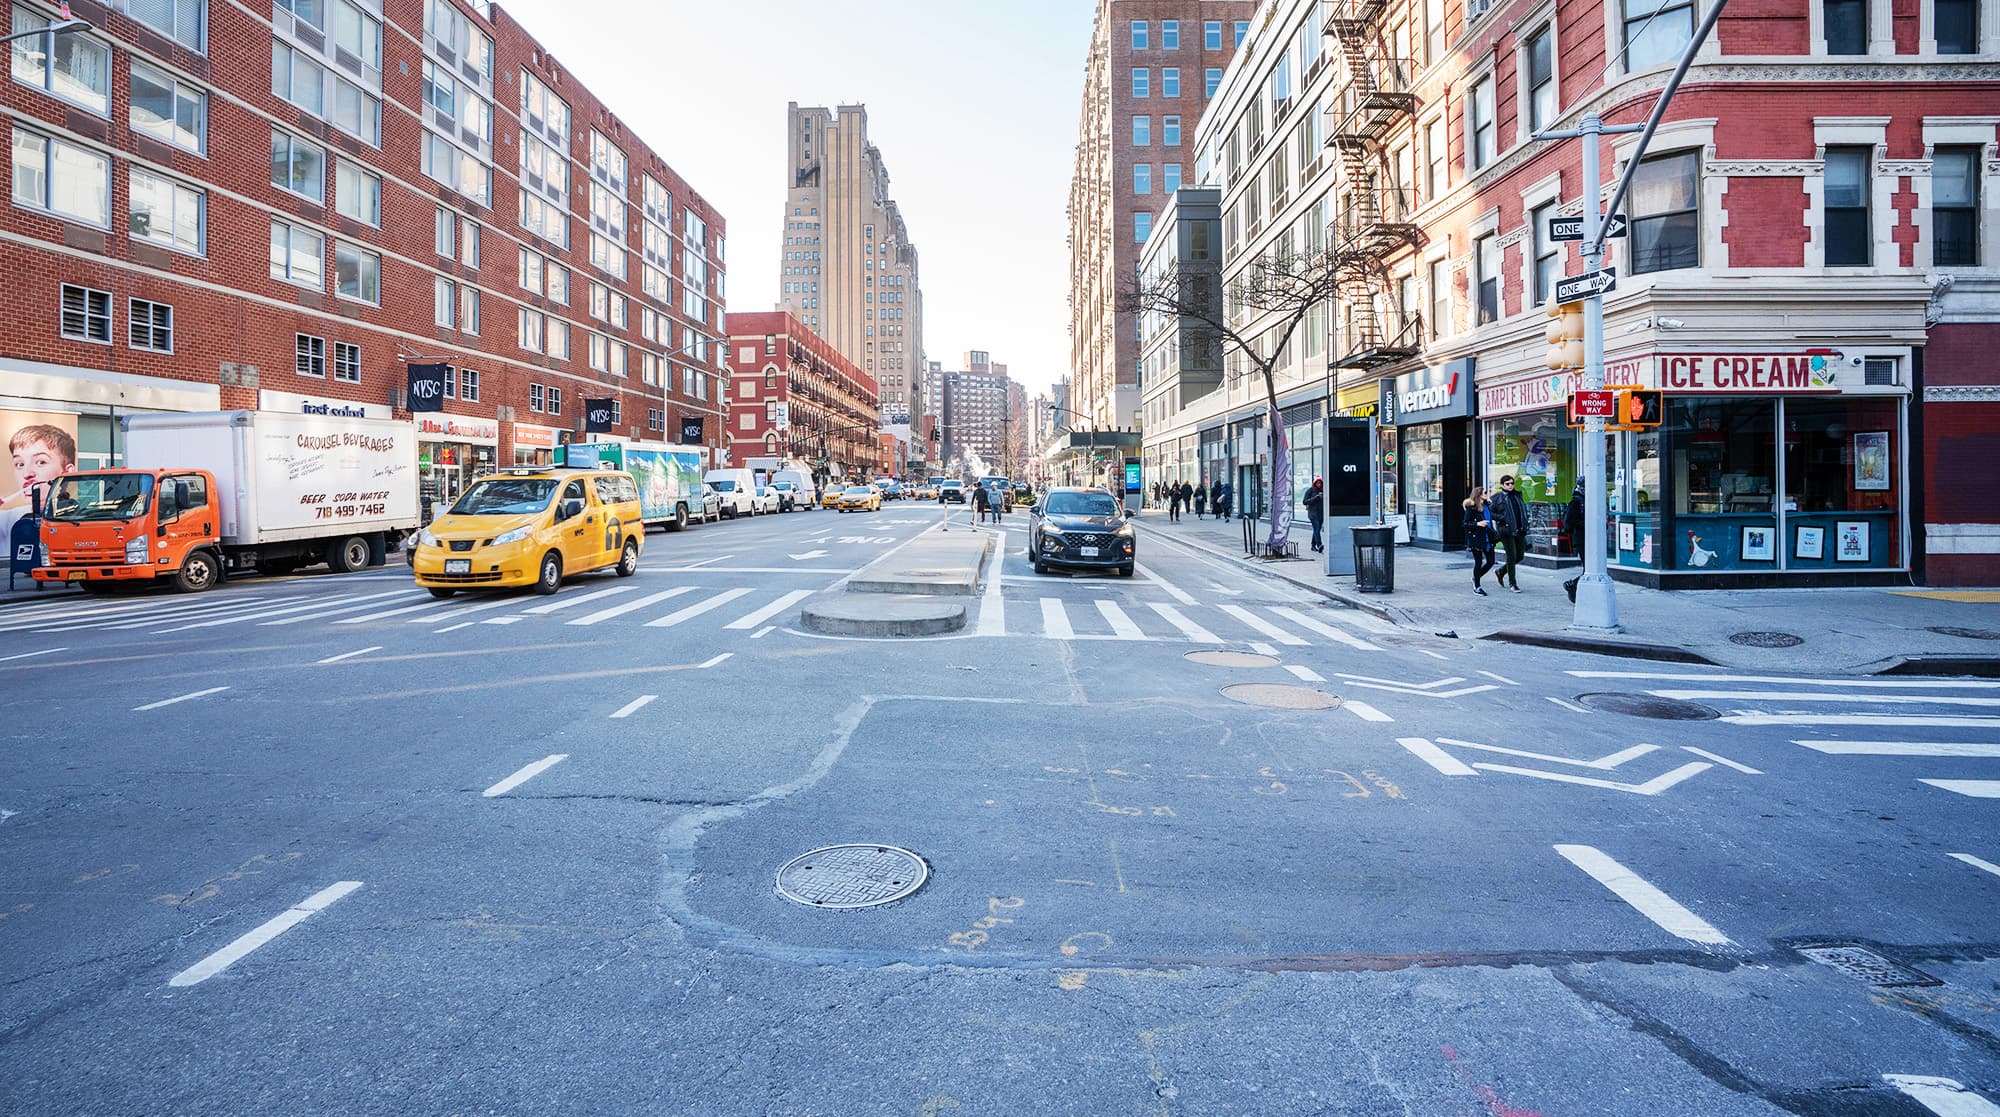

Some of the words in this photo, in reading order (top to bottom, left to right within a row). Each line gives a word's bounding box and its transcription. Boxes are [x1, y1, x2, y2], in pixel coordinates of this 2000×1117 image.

[1556, 224, 1580, 234] ONE
[1561, 283, 1580, 296] ONE
[1590, 276, 1609, 288] WAY
[1661, 357, 1704, 388] ICE
[1713, 357, 1809, 388] CREAM
[413, 379, 441, 399] NYSC
[1485, 386, 1517, 412] AMPLE
[1519, 380, 1549, 407] HILLS
[1398, 383, 1451, 414] verizon
[1581, 399, 1607, 407] WRONG
[1384, 391, 1393, 423] verizon
[590, 409, 610, 423] NYSC
[684, 425, 701, 436] NYSC
[297, 433, 341, 450] CAROUSEL
[343, 433, 394, 452] BEVERAGES
[1343, 464, 1357, 472] on
[1616, 471, 1623, 481] A
[300, 494, 327, 505] BEER
[332, 492, 357, 503] SODA
[360, 491, 390, 501] WATER
[315, 506, 332, 519] 718
[574, 528, 584, 537] NYC
